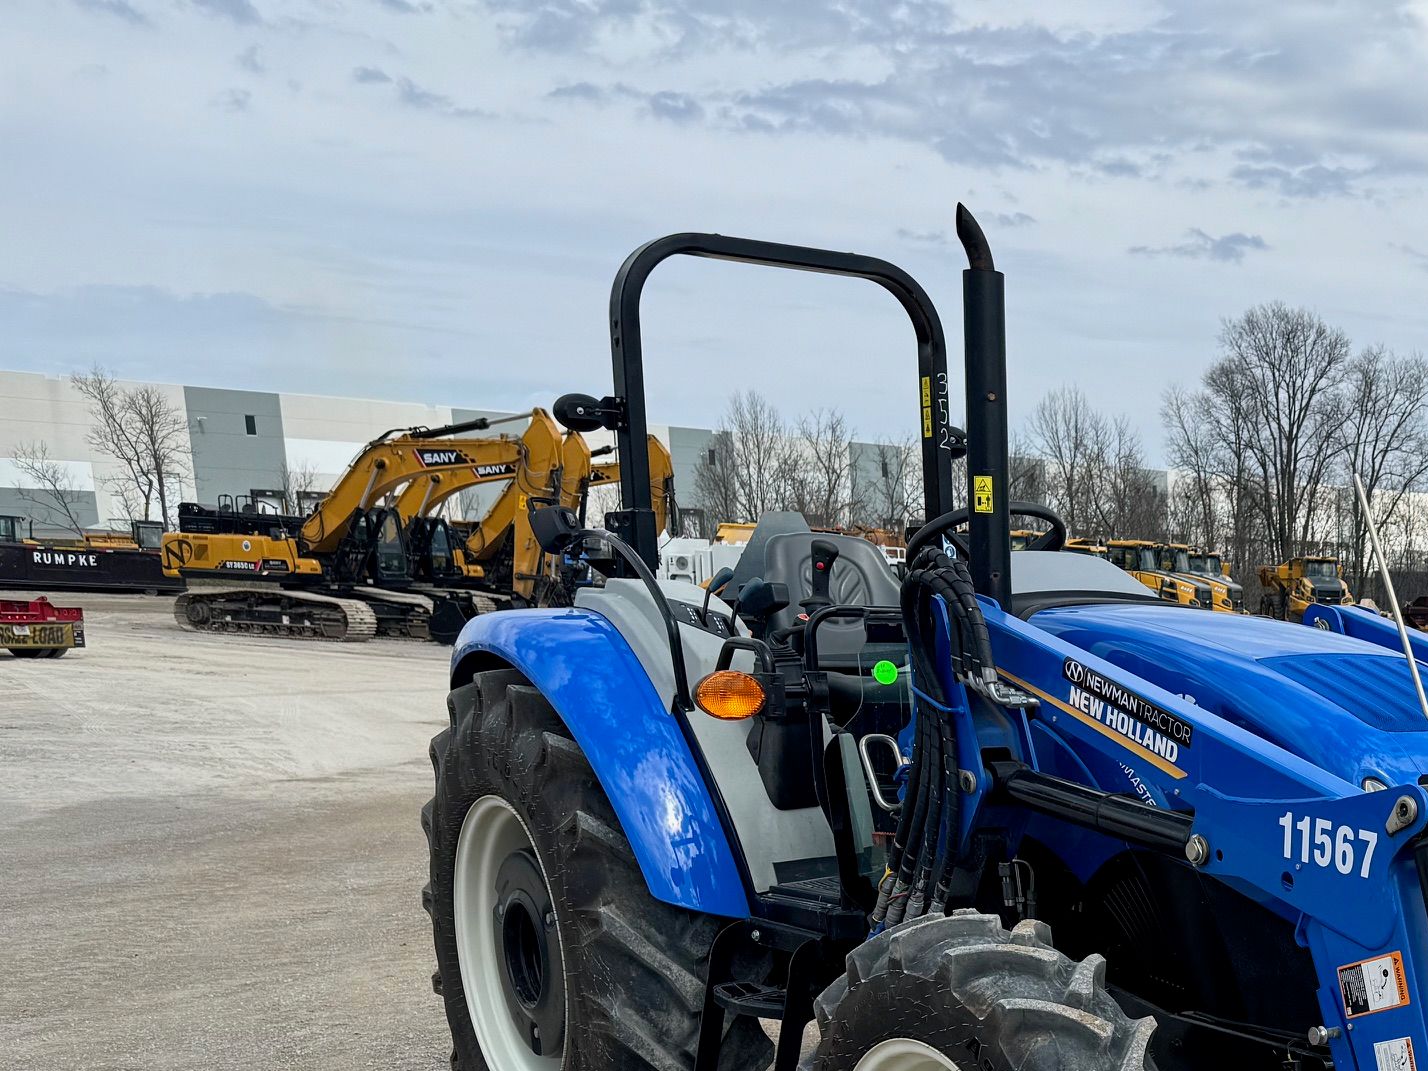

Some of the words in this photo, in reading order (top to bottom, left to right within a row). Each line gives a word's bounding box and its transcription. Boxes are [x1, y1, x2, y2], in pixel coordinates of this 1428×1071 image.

[423, 452, 457, 464] SANY
[477, 464, 506, 475] SANY
[32, 551, 98, 567] RUMPKE
[32, 626, 64, 645] LOAD
[1069, 685, 1105, 721] NEW
[1105, 705, 1178, 763] HOLLAND
[1278, 811, 1378, 879] 11567
[1395, 966, 1406, 1001] WARNING
